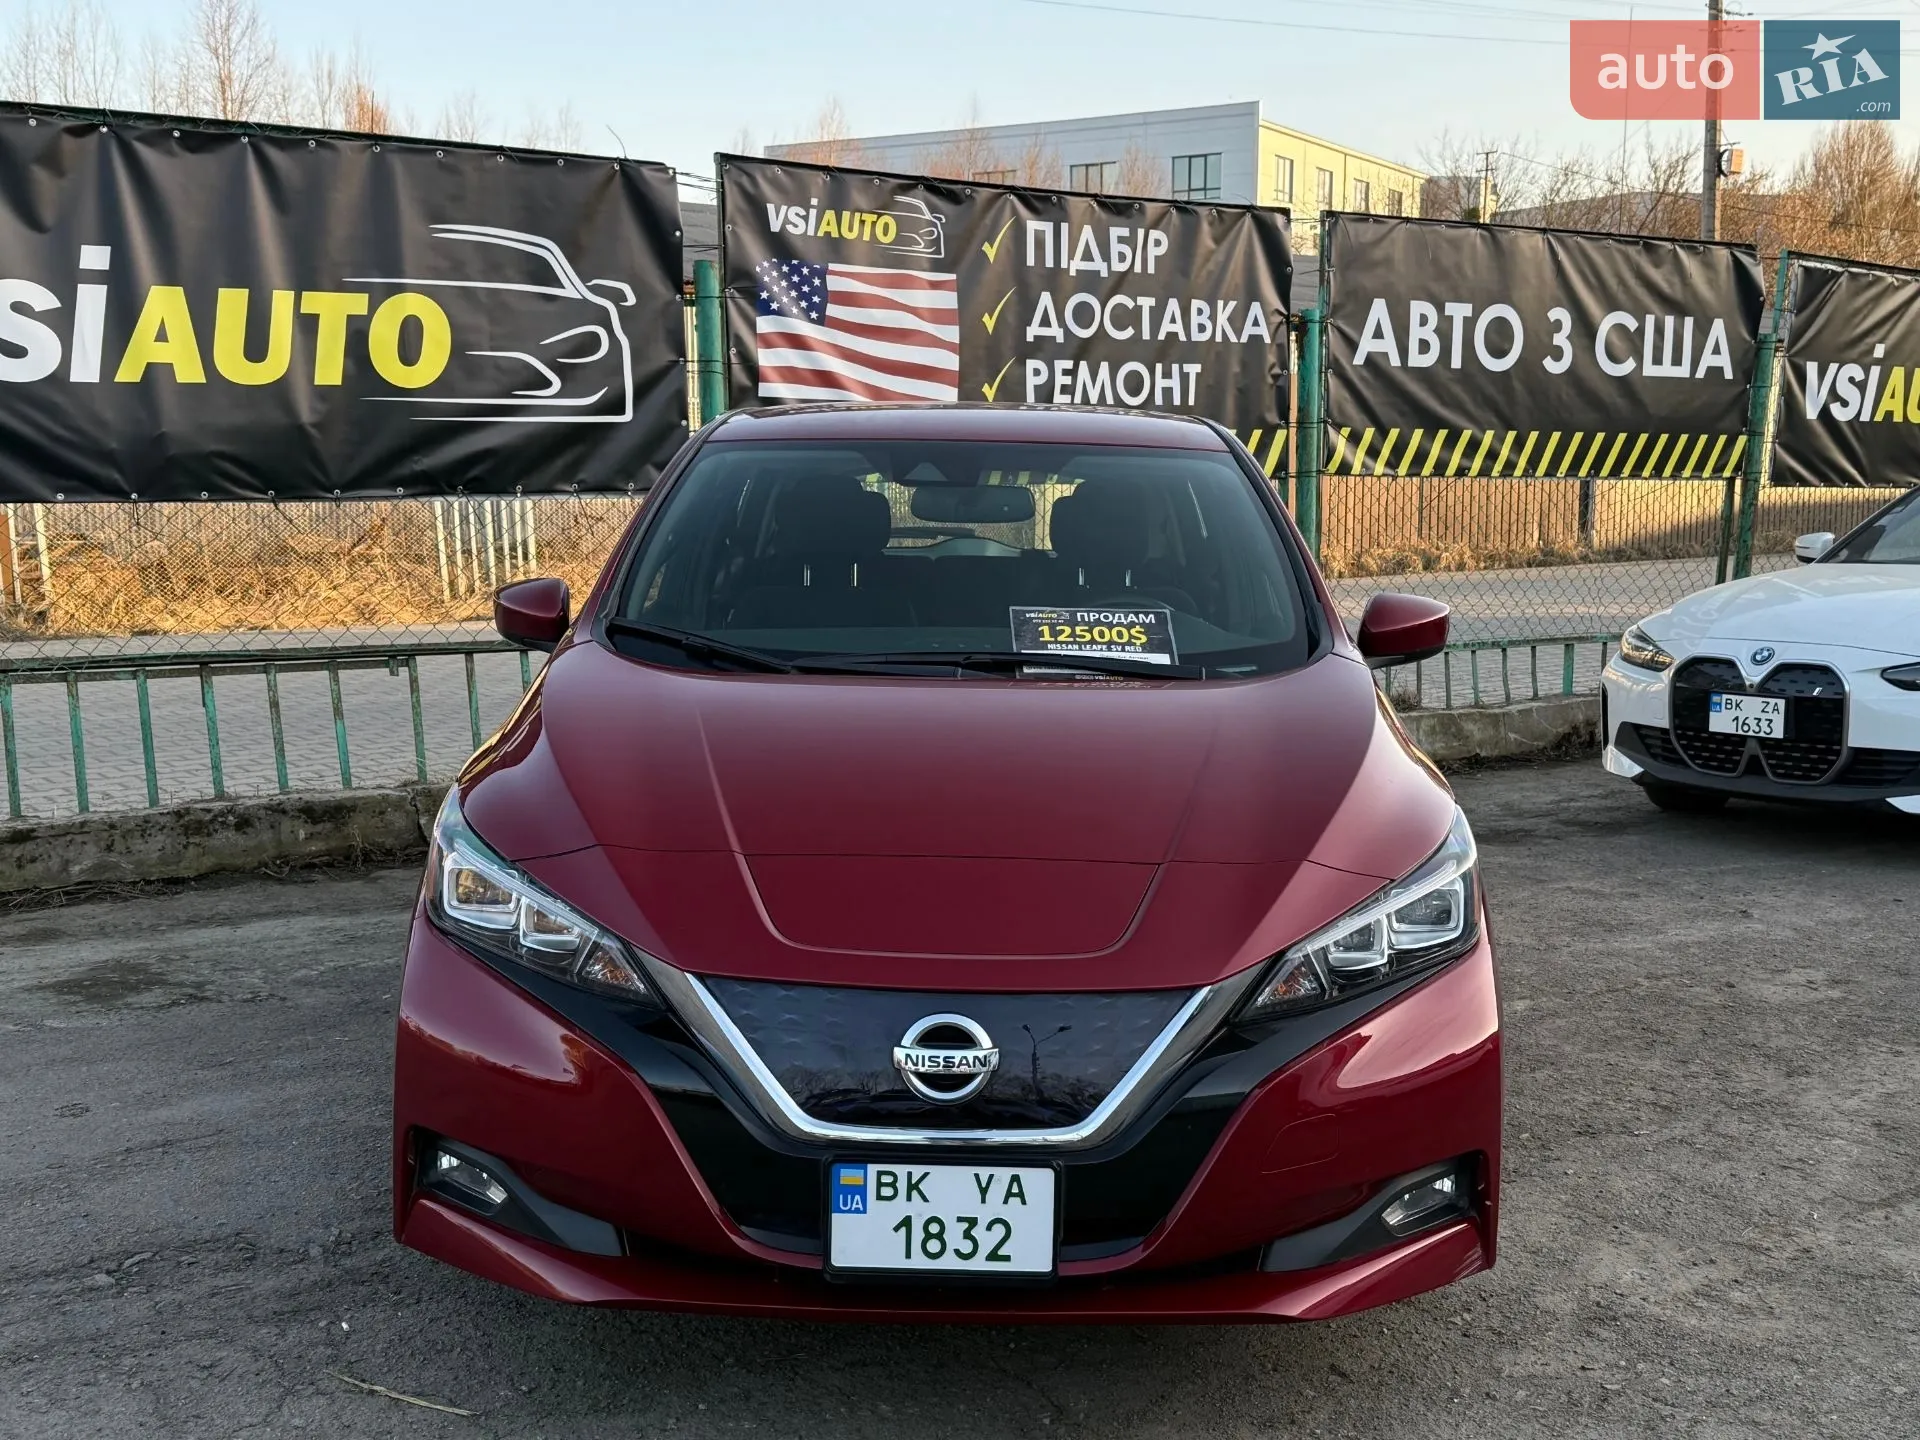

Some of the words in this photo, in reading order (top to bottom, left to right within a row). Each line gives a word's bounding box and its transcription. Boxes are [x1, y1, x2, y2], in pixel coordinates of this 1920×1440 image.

[1026, 219, 1169, 278] ПІДБІР
[1026, 291, 1271, 344] ДОСТАВКА
[1353, 298, 1524, 373] АВТО
[1595, 310, 1734, 380] США
[1026, 359, 1201, 407] РЕМОНТ
[1076, 611, 1156, 625] ПРОДАМ
[1038, 625, 1148, 646] 12500$
[1724, 698, 1744, 711] BK
[1760, 701, 1780, 714] ZA
[1732, 715, 1774, 736] 1633
[904, 1053, 989, 1069] NISSAN
[875, 1170, 931, 1203] BK
[973, 1172, 1027, 1206] YA
[839, 1194, 864, 1211] UA
[892, 1215, 1012, 1262] 1832
